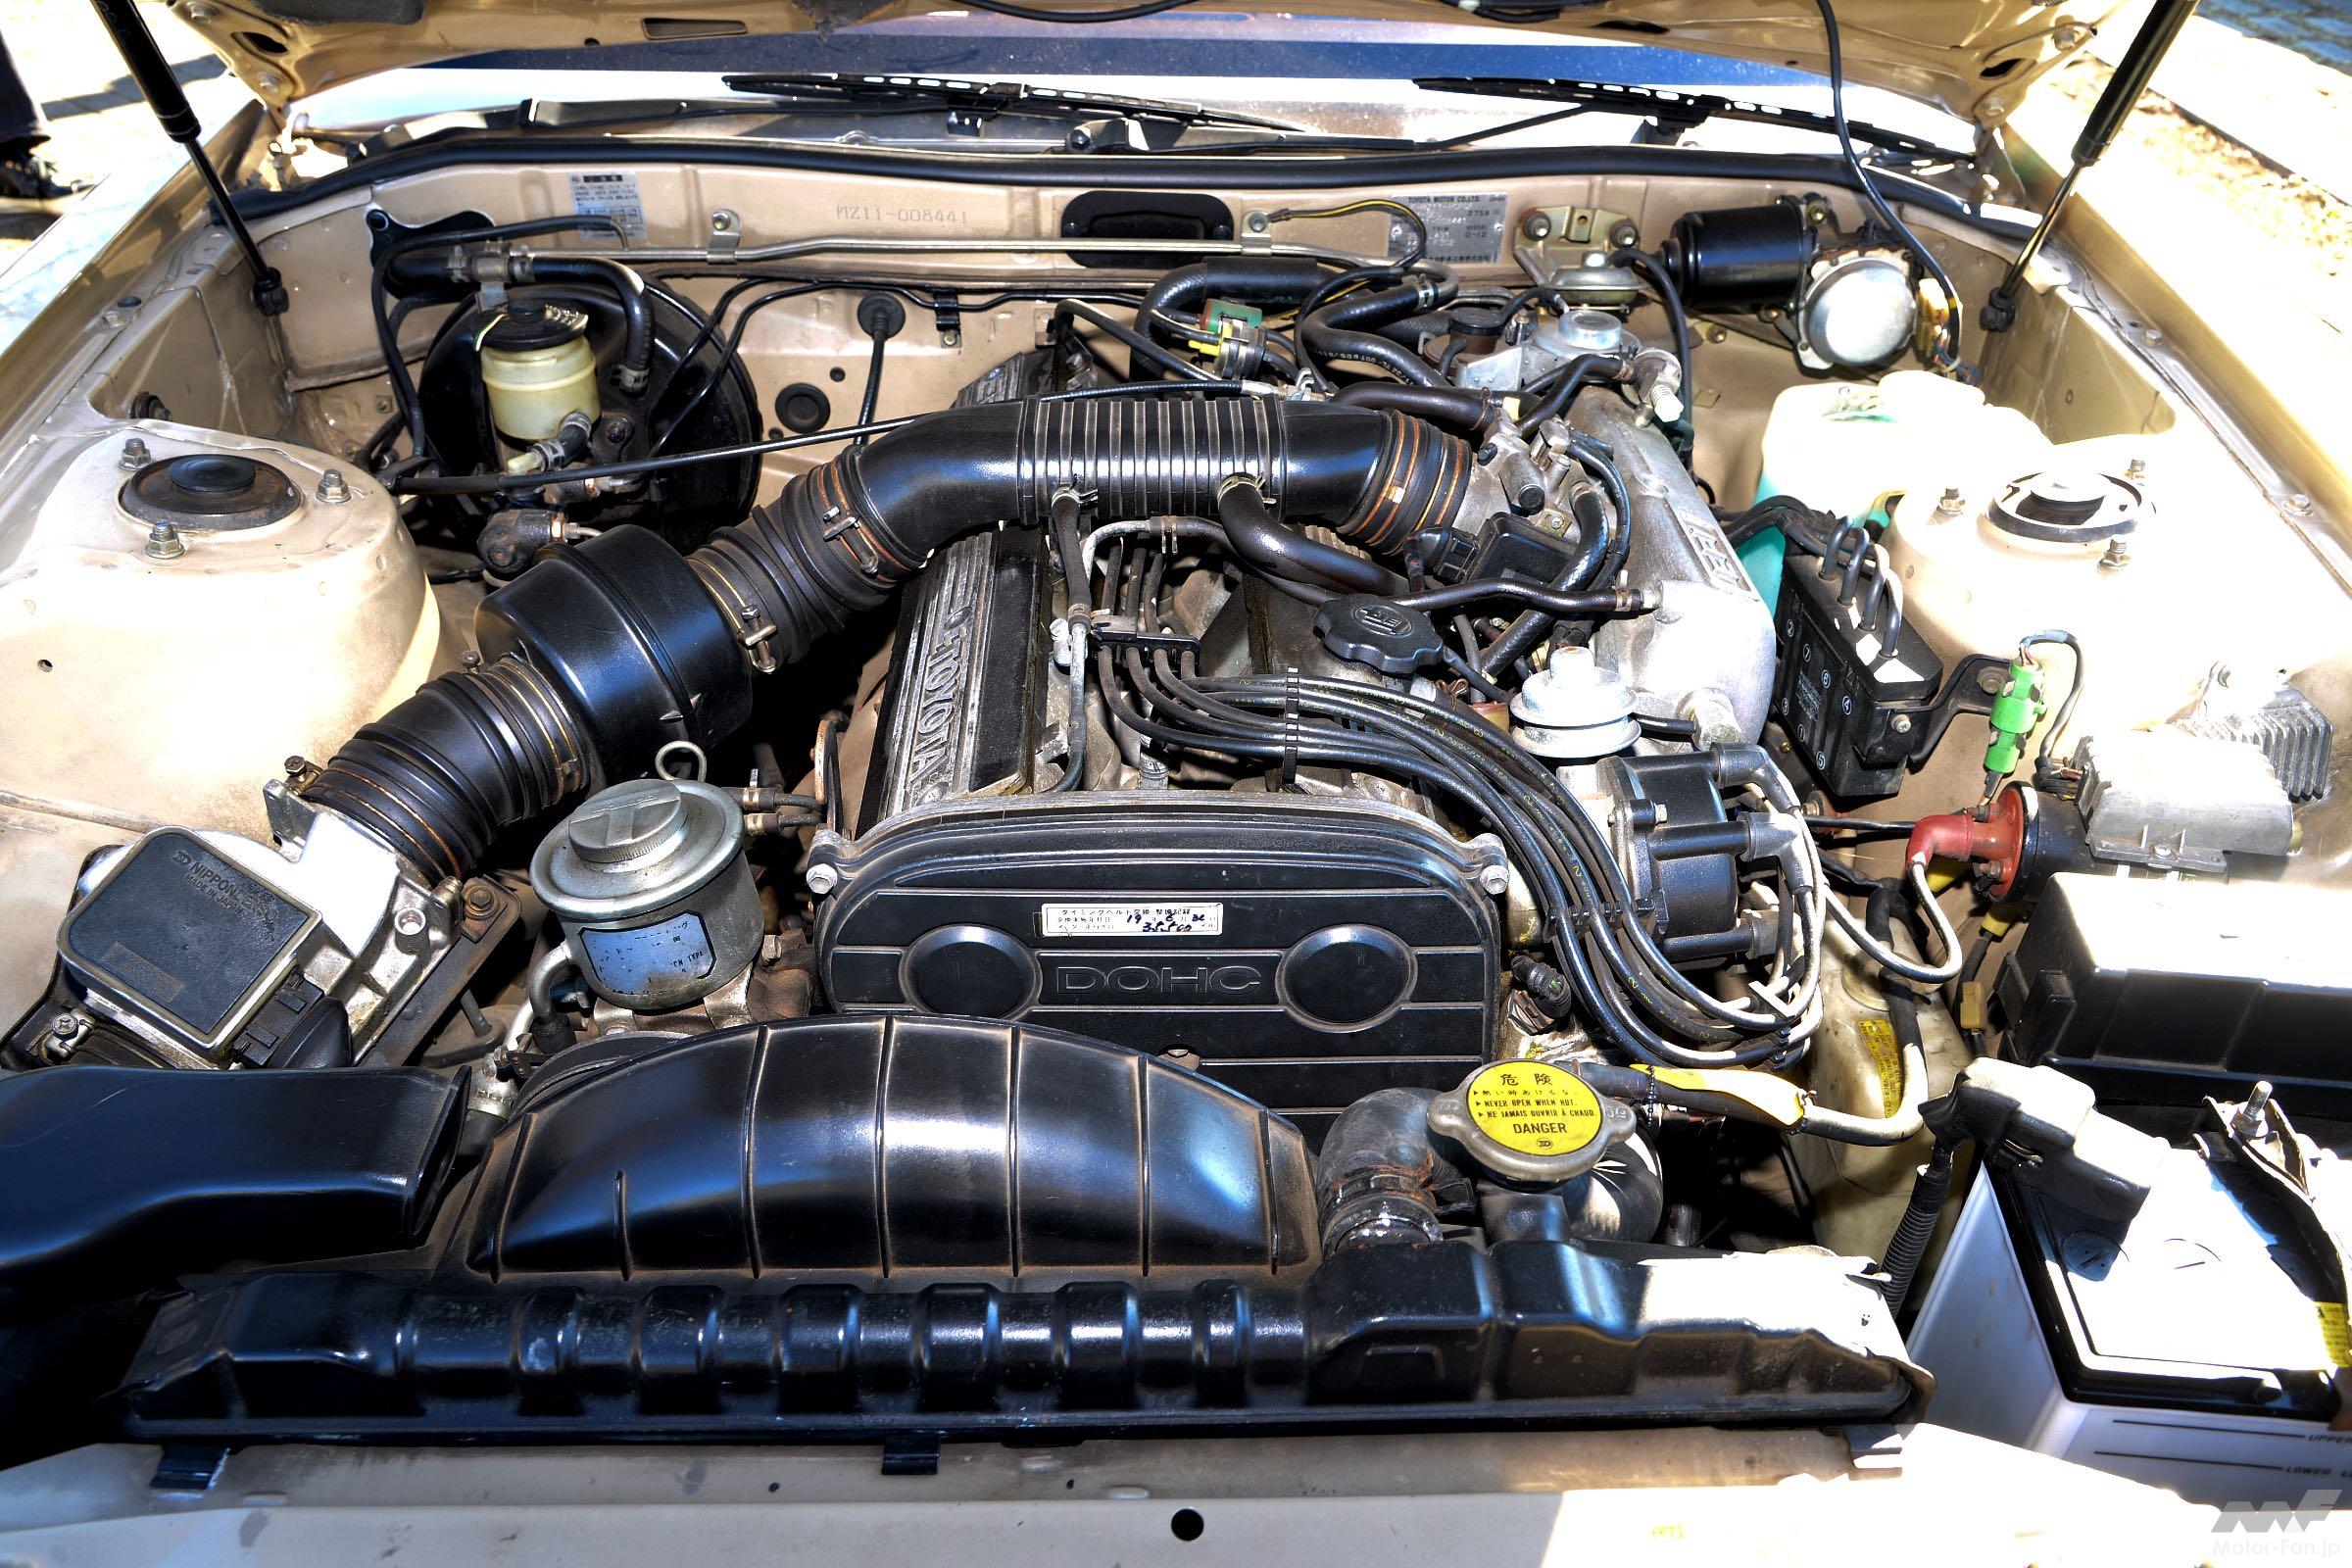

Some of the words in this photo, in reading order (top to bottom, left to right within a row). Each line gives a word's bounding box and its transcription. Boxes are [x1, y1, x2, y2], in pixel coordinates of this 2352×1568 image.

[836, 205, 967, 224] MZ11-008441
[909, 643, 962, 783] TOYOTA
[1057, 965, 1262, 995] DOHC
[1499, 1073, 1553, 1086] 危険
[1513, 1123, 1568, 1134] DANGER
[2285, 1466, 2331, 1476] LOWER
